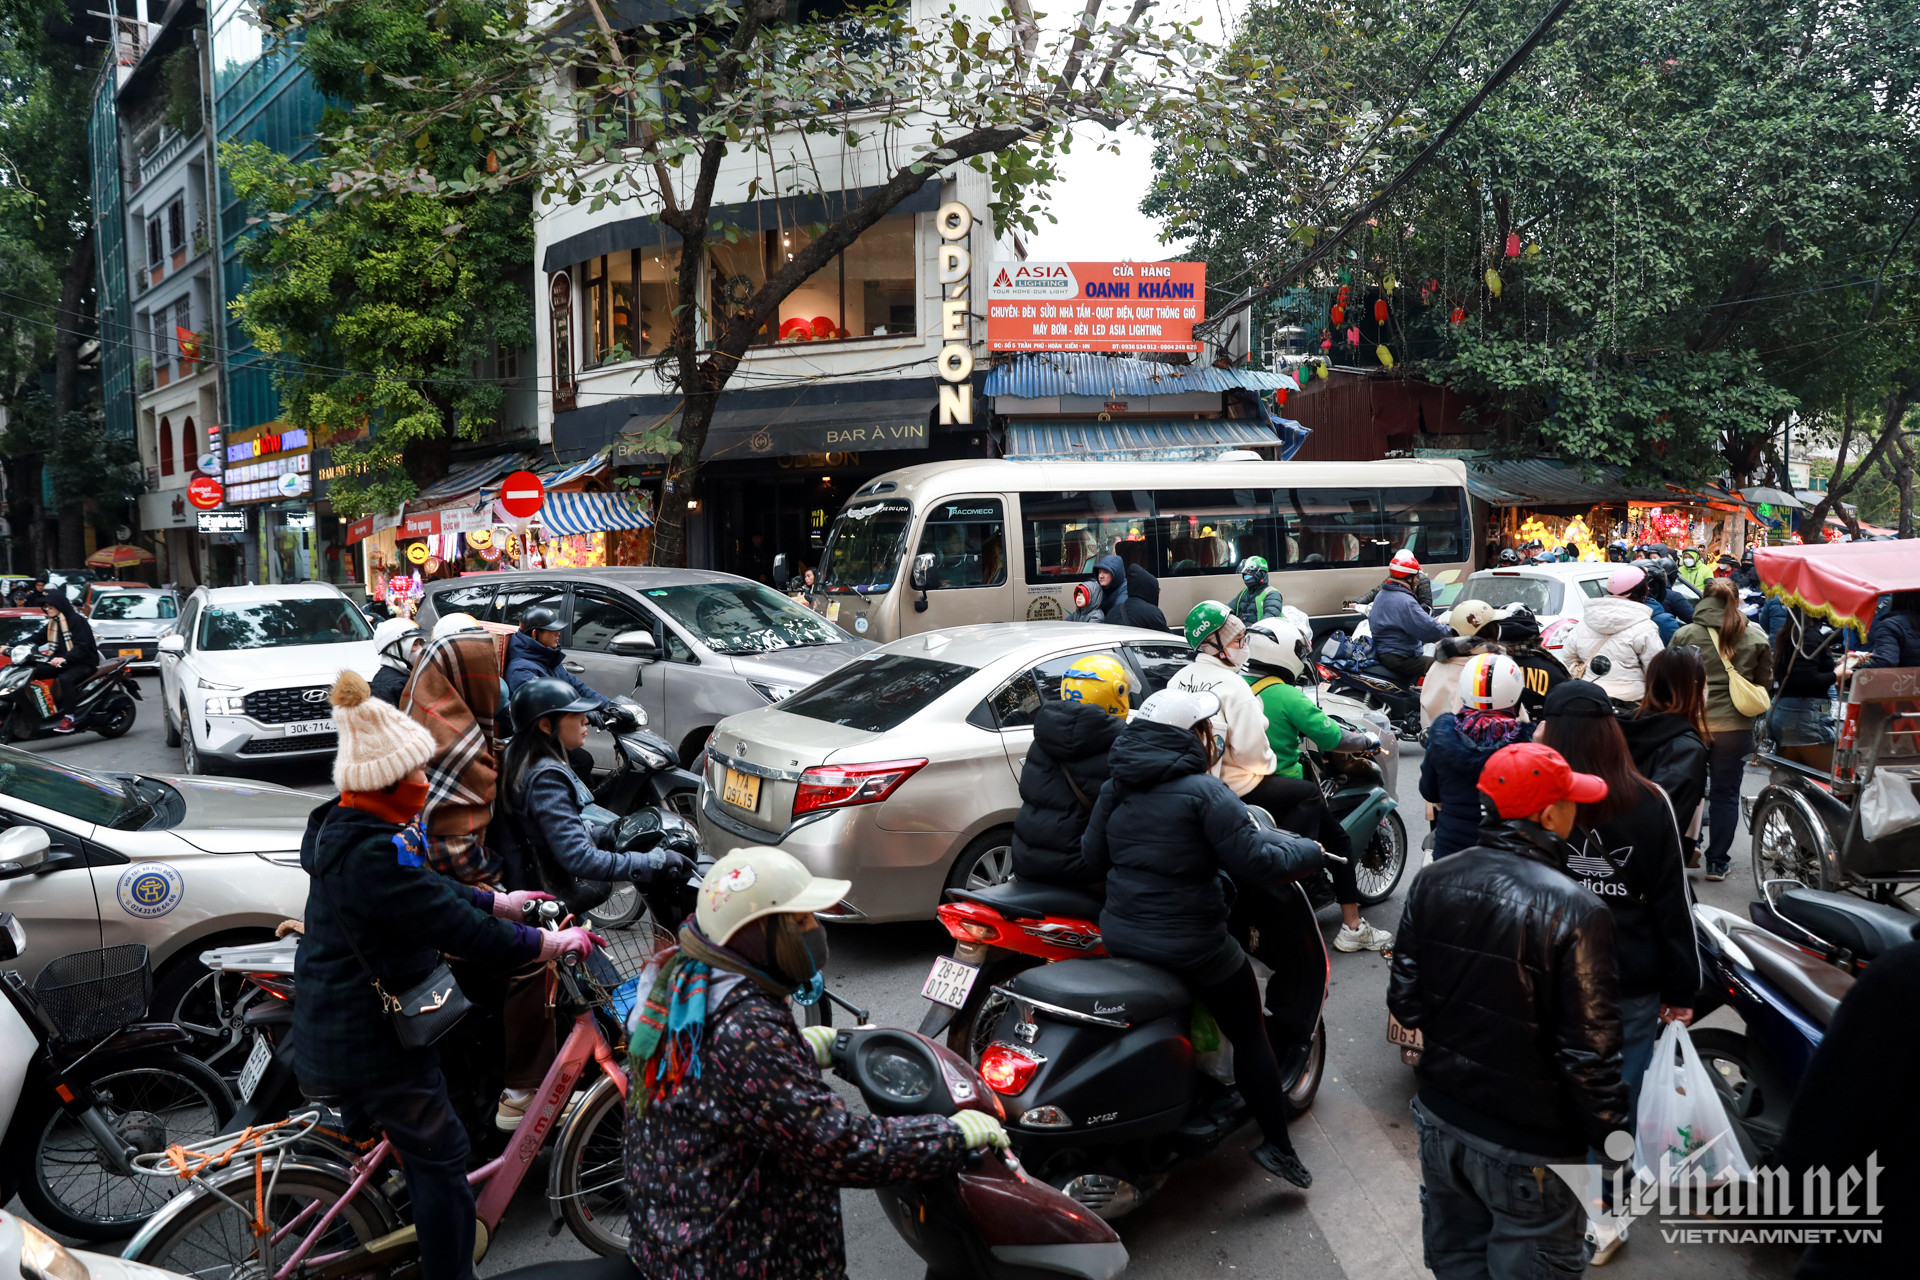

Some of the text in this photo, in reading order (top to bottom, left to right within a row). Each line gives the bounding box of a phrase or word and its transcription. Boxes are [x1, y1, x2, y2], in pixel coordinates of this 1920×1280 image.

[1016, 266, 1068, 277] ASIA
[1112, 263, 1170, 276] CỬA HÀNG
[1086, 279, 1194, 298] OANH KHÁNH
[936, 200, 974, 425] ODÉON
[991, 304, 1020, 318] CHUYÊN:
[1060, 305, 1073, 318] NHÀ
[1183, 305, 1196, 319] GIÓ
[1033, 322, 1048, 335] MÁY
[1092, 324, 1105, 335] LED
[1109, 324, 1126, 335] ASIA
[1129, 325, 1162, 336] LIGHTING
[827, 425, 923, 442] BAR À VIN
[945, 506, 993, 518] TRACOMECO
[1192, 620, 1211, 638] Grab
[291, 722, 336, 733] 30K-714.
[726, 786, 754, 808] 097.15
[937, 961, 970, 984] 28-P1
[926, 979, 966, 1006] 017.85
